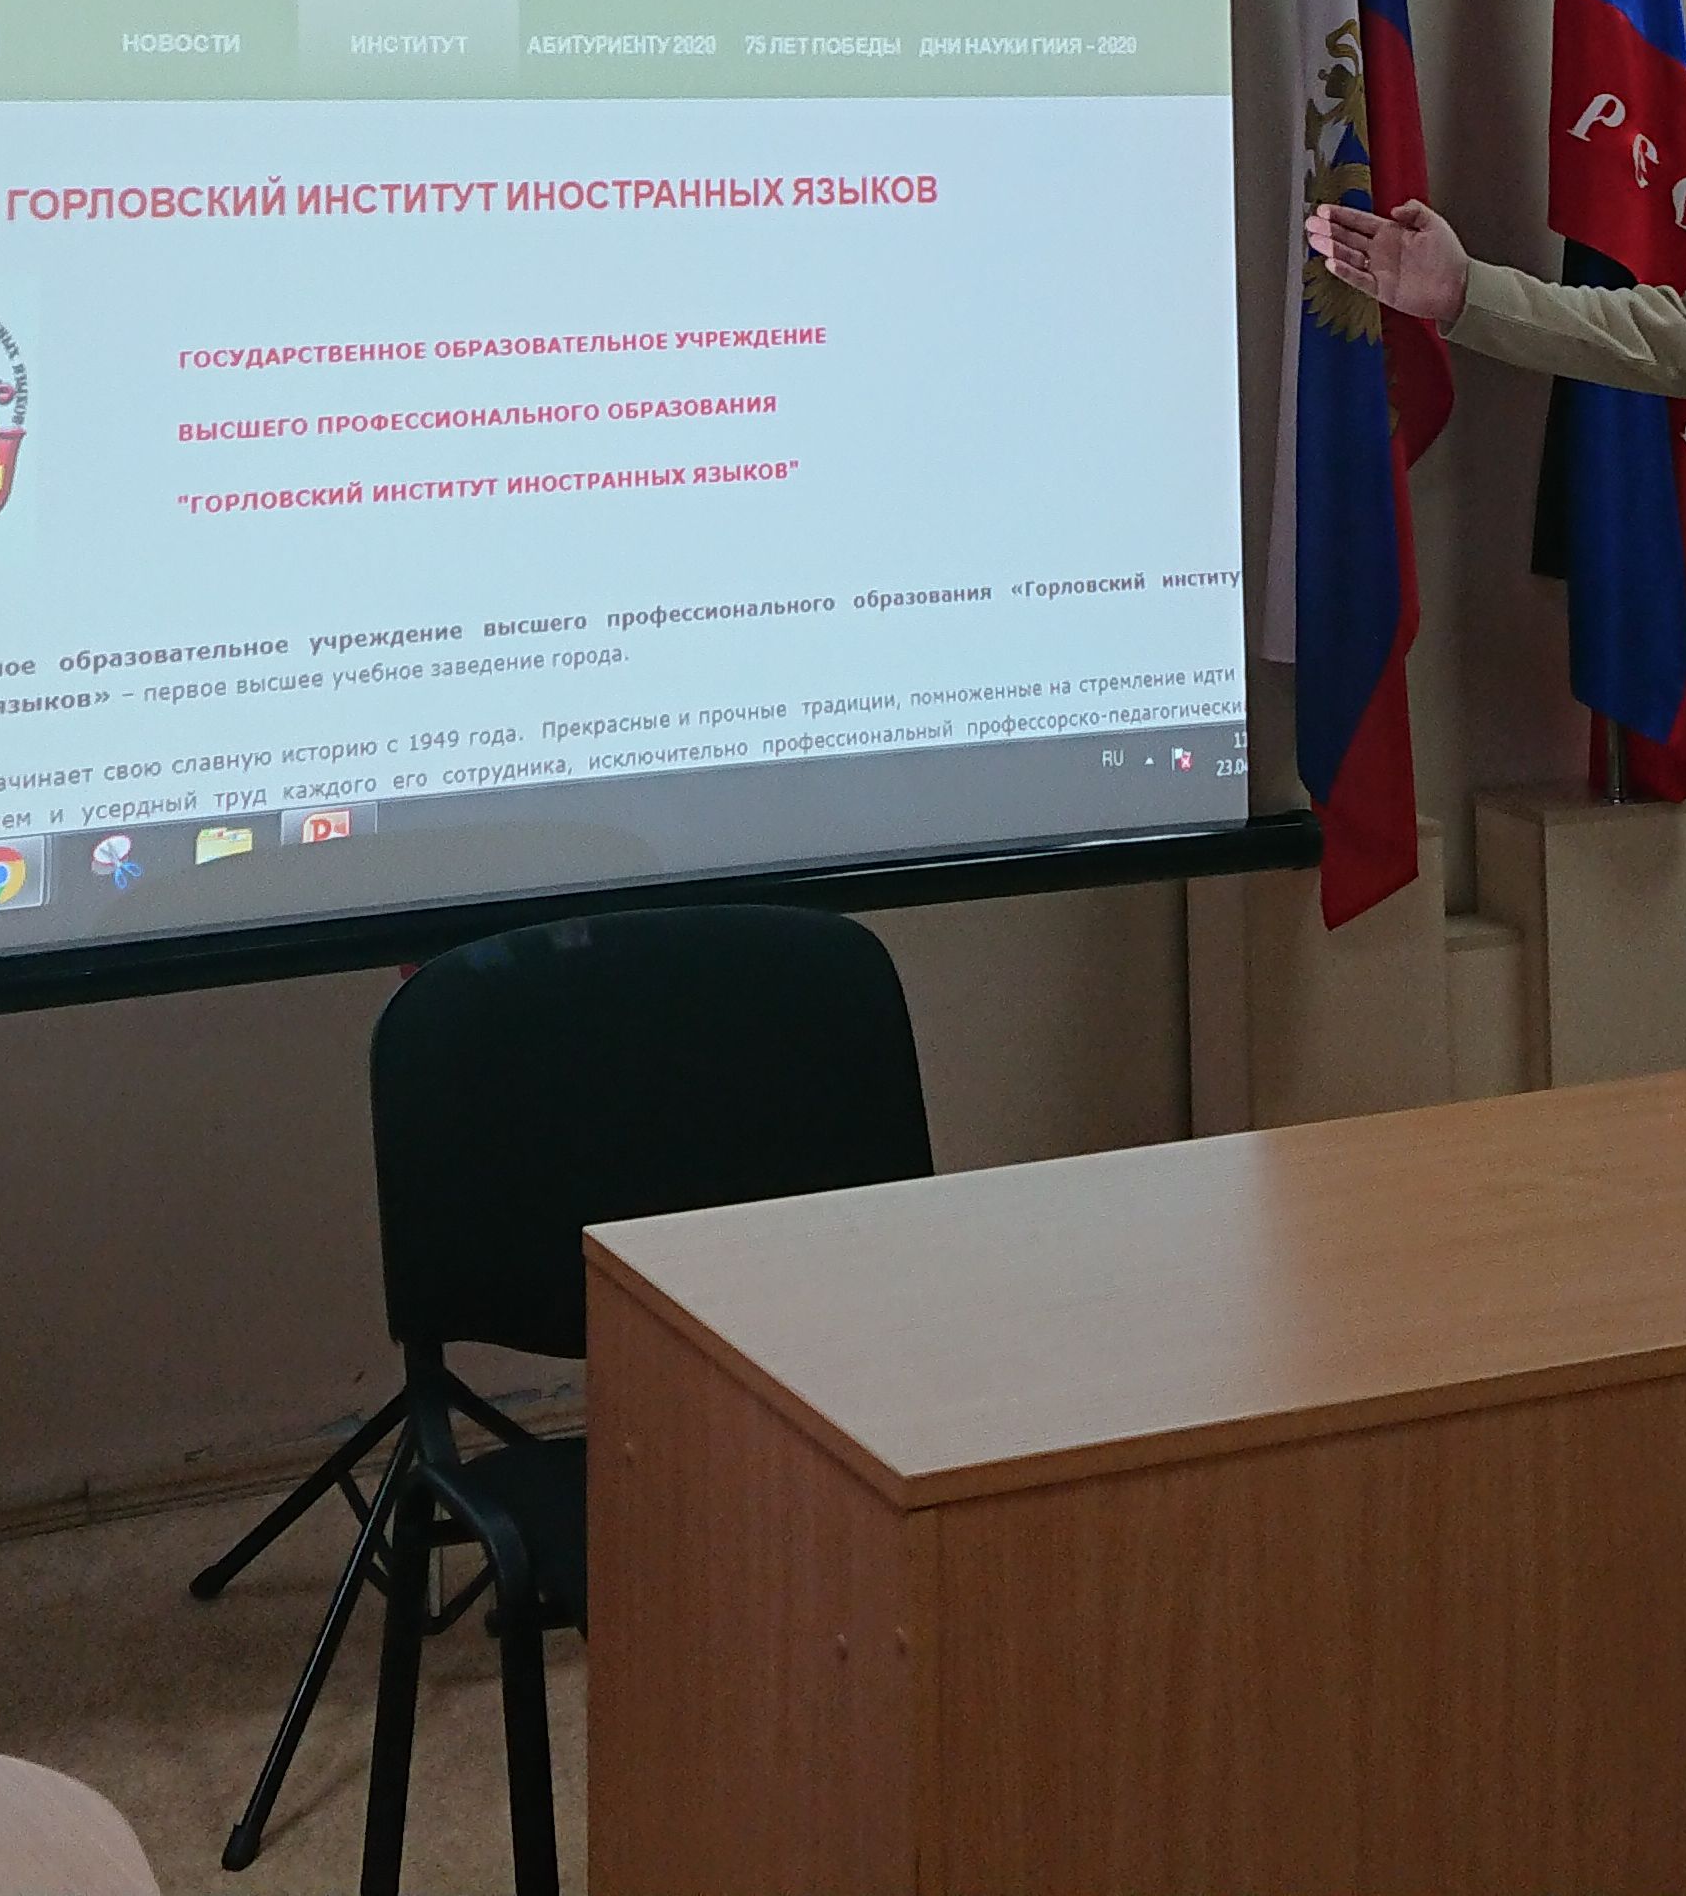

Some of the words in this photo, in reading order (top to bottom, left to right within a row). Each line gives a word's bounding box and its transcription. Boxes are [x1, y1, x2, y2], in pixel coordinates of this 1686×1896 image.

[123, 32, 240, 55] НОВОСТИ
[350, 34, 469, 55] ИНСТИТУТ
[527, 35, 671, 56] АБИТУРИЕНТУ
[673, 35, 716, 55] 2020
[745, 36, 767, 55] 75
[770, 36, 809, 55] ЛЕТ
[812, 36, 901, 58] ПОБЕДЫ
[919, 36, 961, 58] ДНИ
[965, 37, 1030, 55] НАУКИ
[1032, 37, 1083, 55] ГИИЯ
[1098, 36, 1138, 55] 2020
[7, 177, 286, 220] ГОРЛОВСКИЙ
[296, 182, 498, 216] ИНСТИТУТ
[506, 178, 785, 212] ИНОСТРАННЫХ
[792, 175, 938, 205] ЯЗЫКОВ
[179, 339, 427, 369] ГОСУДАРСТВЕННОЕ
[435, 331, 668, 359] ОБРАЗОВАТЕЛЬНОЕ
[675, 327, 827, 350] УЧРЕЖДЕНИЕ
[178, 417, 308, 443] ВЫСШЕГО
[317, 402, 599, 435] ПРОФЕССИОНАЛЬНОГО
[608, 395, 777, 419] ОБРАЗОВАНИЯ
[178, 481, 363, 514] "ГОРЛОВСКИЙ
[373, 478, 498, 502] ИНСТИТУТ
[507, 468, 686, 495] ИНОСТРАННЫХ
[692, 460, 799, 483] ЯЗЫКОВ"
[59, 635, 289, 673] образовательное
[310, 622, 463, 656] учреждение
[484, 613, 587, 638] высшего
[607, 595, 835, 629] профессионального
[853, 583, 992, 610] образования
[1011, 572, 1145, 598] «Горловский
[143, 679, 227, 706] первое
[237, 671, 323, 696] высшее
[332, 660, 423, 689] учебное
[431, 653, 545, 678] заведение
[552, 645, 630, 672] города.
[104, 759, 162, 781] свою
[172, 747, 272, 776] славную
[282, 738, 377, 765] историю
[387, 737, 398, 753] с
[409, 729, 460, 752] 1949
[469, 725, 524, 746] года.
[541, 713, 670, 740] Прекрасные
[679, 712, 691, 727] и
[698, 700, 787, 725] прочные
[802, 692, 901, 719] традиции,
[1050, 679, 1072, 696] на
[1079, 669, 1186, 696] стремление
[1193, 665, 1235, 684] идти
[50, 806, 63, 824] и
[81, 791, 197, 825] усердный
[214, 786, 267, 813] труд
[283, 776, 376, 801] каждого
[392, 771, 427, 792] его
[442, 757, 573, 786] сотрудника,
[588, 741, 748, 771] исключительно
[762, 721, 953, 755] профессиональный
[1101, 751, 1124, 768] RU
